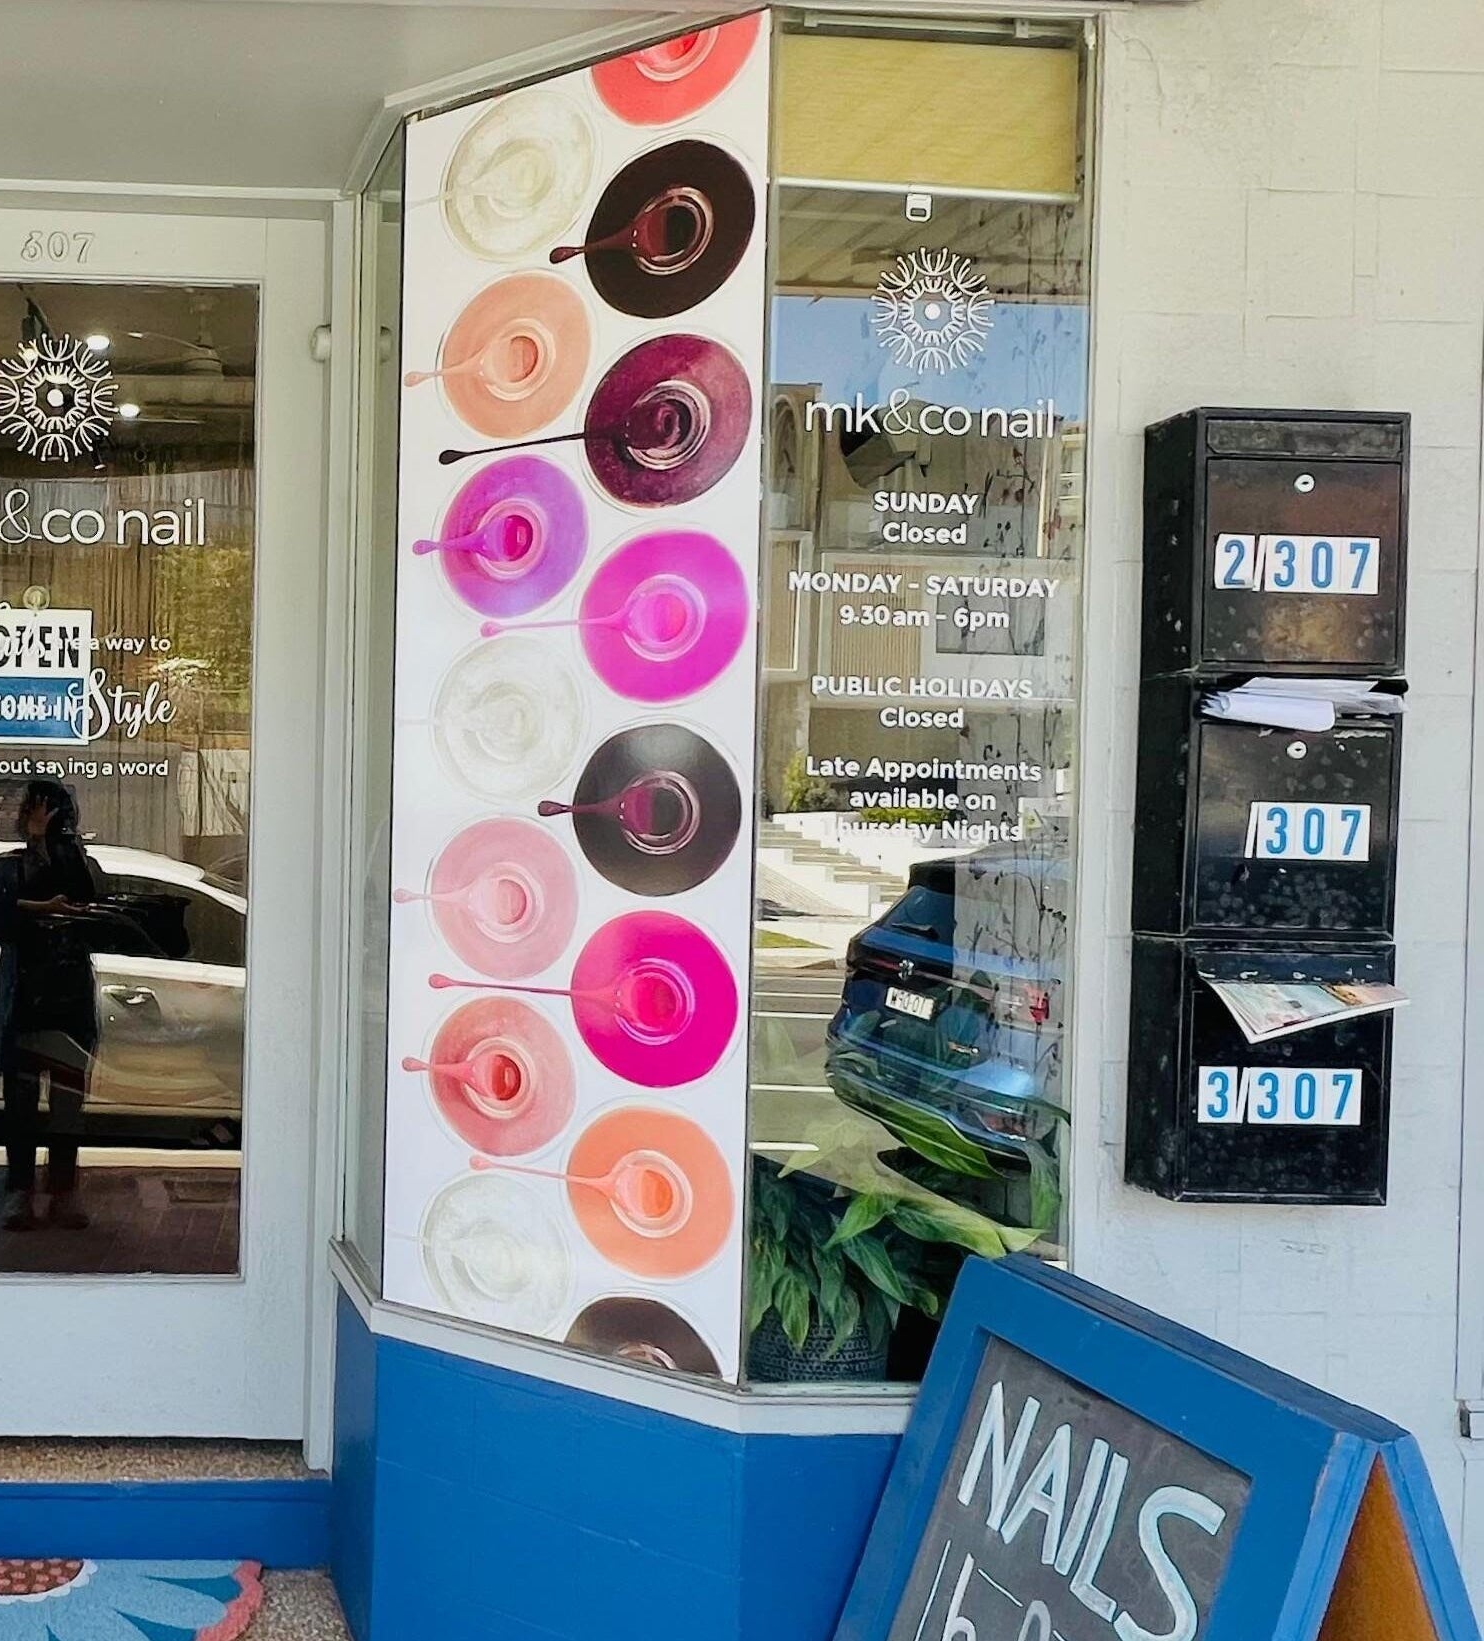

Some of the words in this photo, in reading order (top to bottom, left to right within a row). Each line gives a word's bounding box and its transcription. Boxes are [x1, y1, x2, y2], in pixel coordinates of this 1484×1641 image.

[874, 492, 978, 514] SUNDAY
[882, 522, 967, 545] Closed
[788, 572, 902, 594] MONDAY
[926, 576, 1060, 599] SATURDAY
[953, 608, 1010, 632] 6pm
[90, 637, 100, 651] a
[105, 637, 146, 655] way
[150, 635, 171, 651] to
[811, 676, 902, 696] PUBLIC
[910, 677, 1033, 698] HOLIDAYS
[879, 707, 964, 729] Closed
[101, 762, 113, 776] a
[118, 760, 169, 776] word
[806, 756, 860, 778] Late
[866, 758, 1042, 783] Appointments
[849, 788, 959, 811] available
[965, 793, 997, 811] on
[942, 820, 1024, 844] Nights
[958, 1381, 1227, 1641] NAILS
